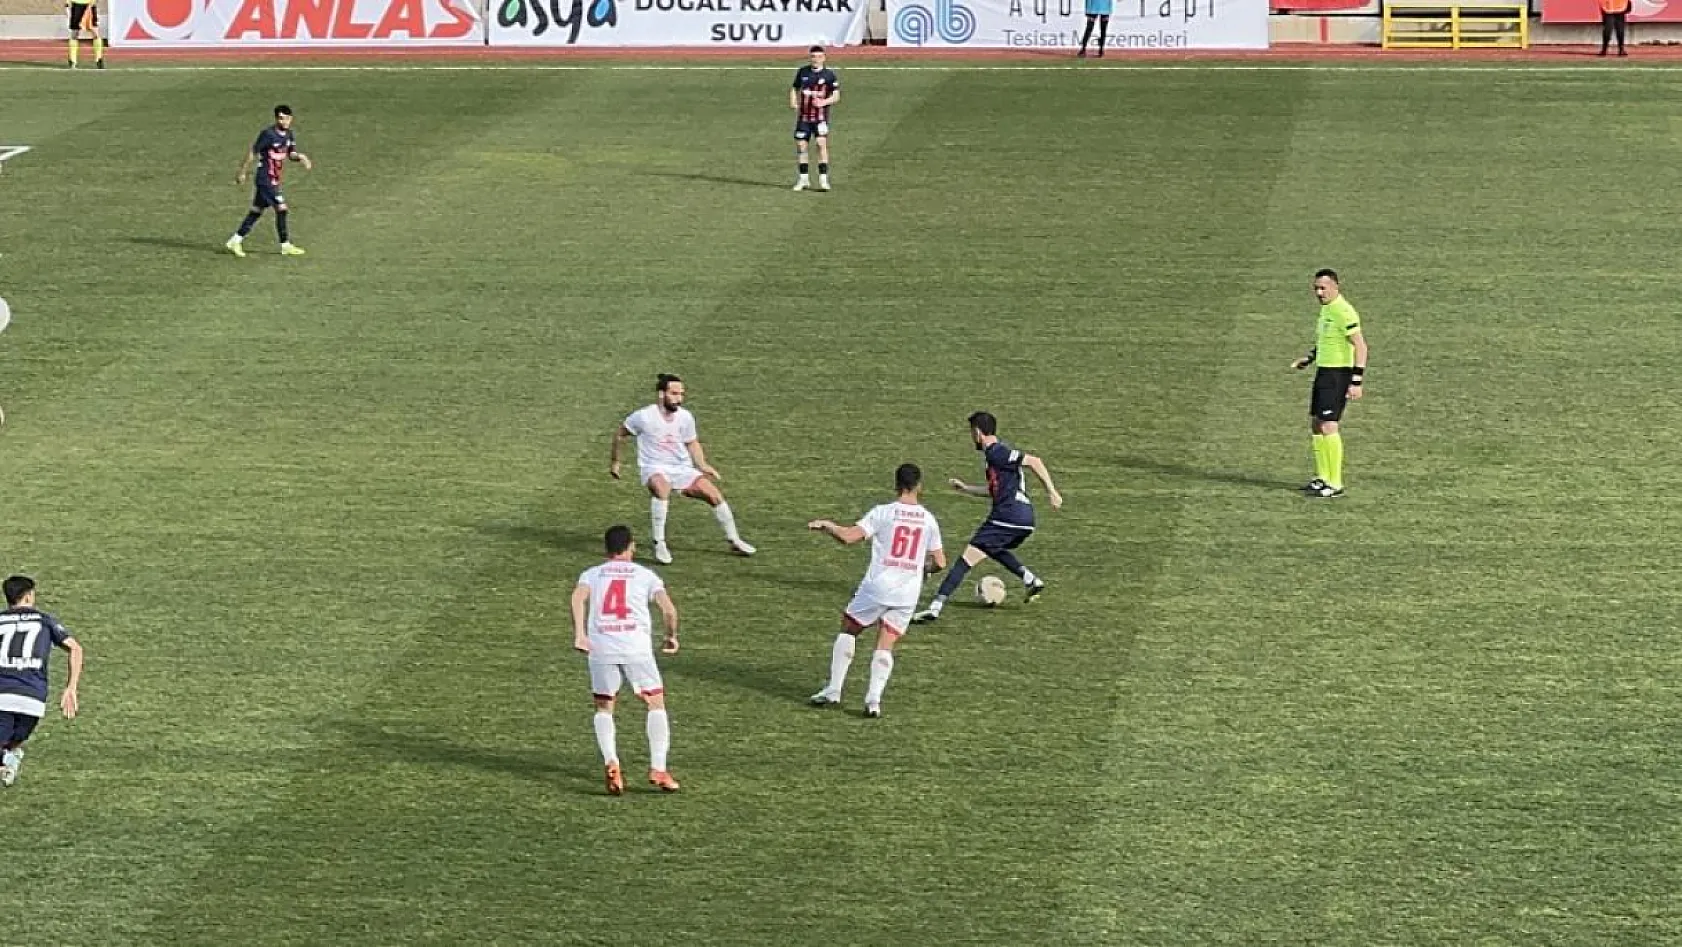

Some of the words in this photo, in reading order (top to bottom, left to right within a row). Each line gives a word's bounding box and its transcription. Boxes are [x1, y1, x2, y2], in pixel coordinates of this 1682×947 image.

[1009, 0, 1072, 23] Aqu
[710, 23, 783, 41] SUYU
[1002, 30, 1066, 46] Tesisat
[1072, 30, 1188, 47] Mazemeleri
[891, 525, 922, 560] 61
[602, 579, 633, 620] 4
[0, 621, 42, 658] 77
